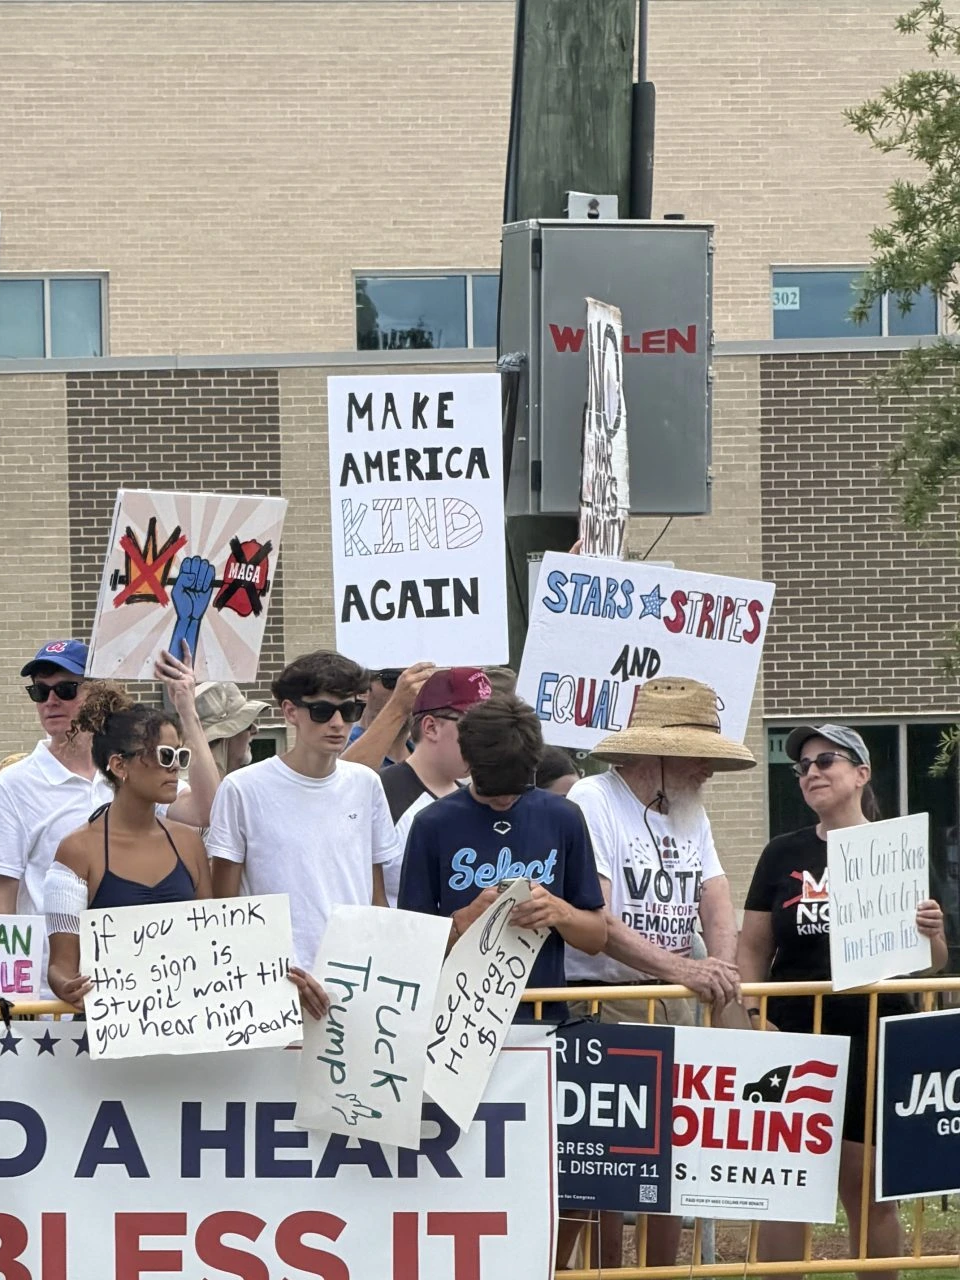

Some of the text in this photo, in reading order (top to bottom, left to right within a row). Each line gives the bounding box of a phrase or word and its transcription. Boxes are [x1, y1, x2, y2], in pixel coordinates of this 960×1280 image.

[773, 292, 798, 305] 302
[549, 324, 696, 353] WLEN
[347, 392, 454, 432] MAKE
[340, 447, 490, 486] AMERICA
[341, 498, 483, 556] KIND
[228, 562, 260, 584] MAGA
[341, 577, 480, 623] AGAIN
[542, 570, 764, 644] STARS STRIPES
[610, 644, 661, 682] AND
[449, 847, 558, 890] Select
[90, 902, 265, 961] if you think
[622, 911, 697, 935] DEMOCRAC
[91, 940, 232, 992] this sign is
[193, 965, 248, 998] wait
[96, 1000, 253, 1054] you hear him
[74, 1100, 151, 1179] A
[570, 1160, 636, 1176] DISTRICT
[640, 1163, 660, 1177] 11
[710, 1165, 807, 1186] SENATE
